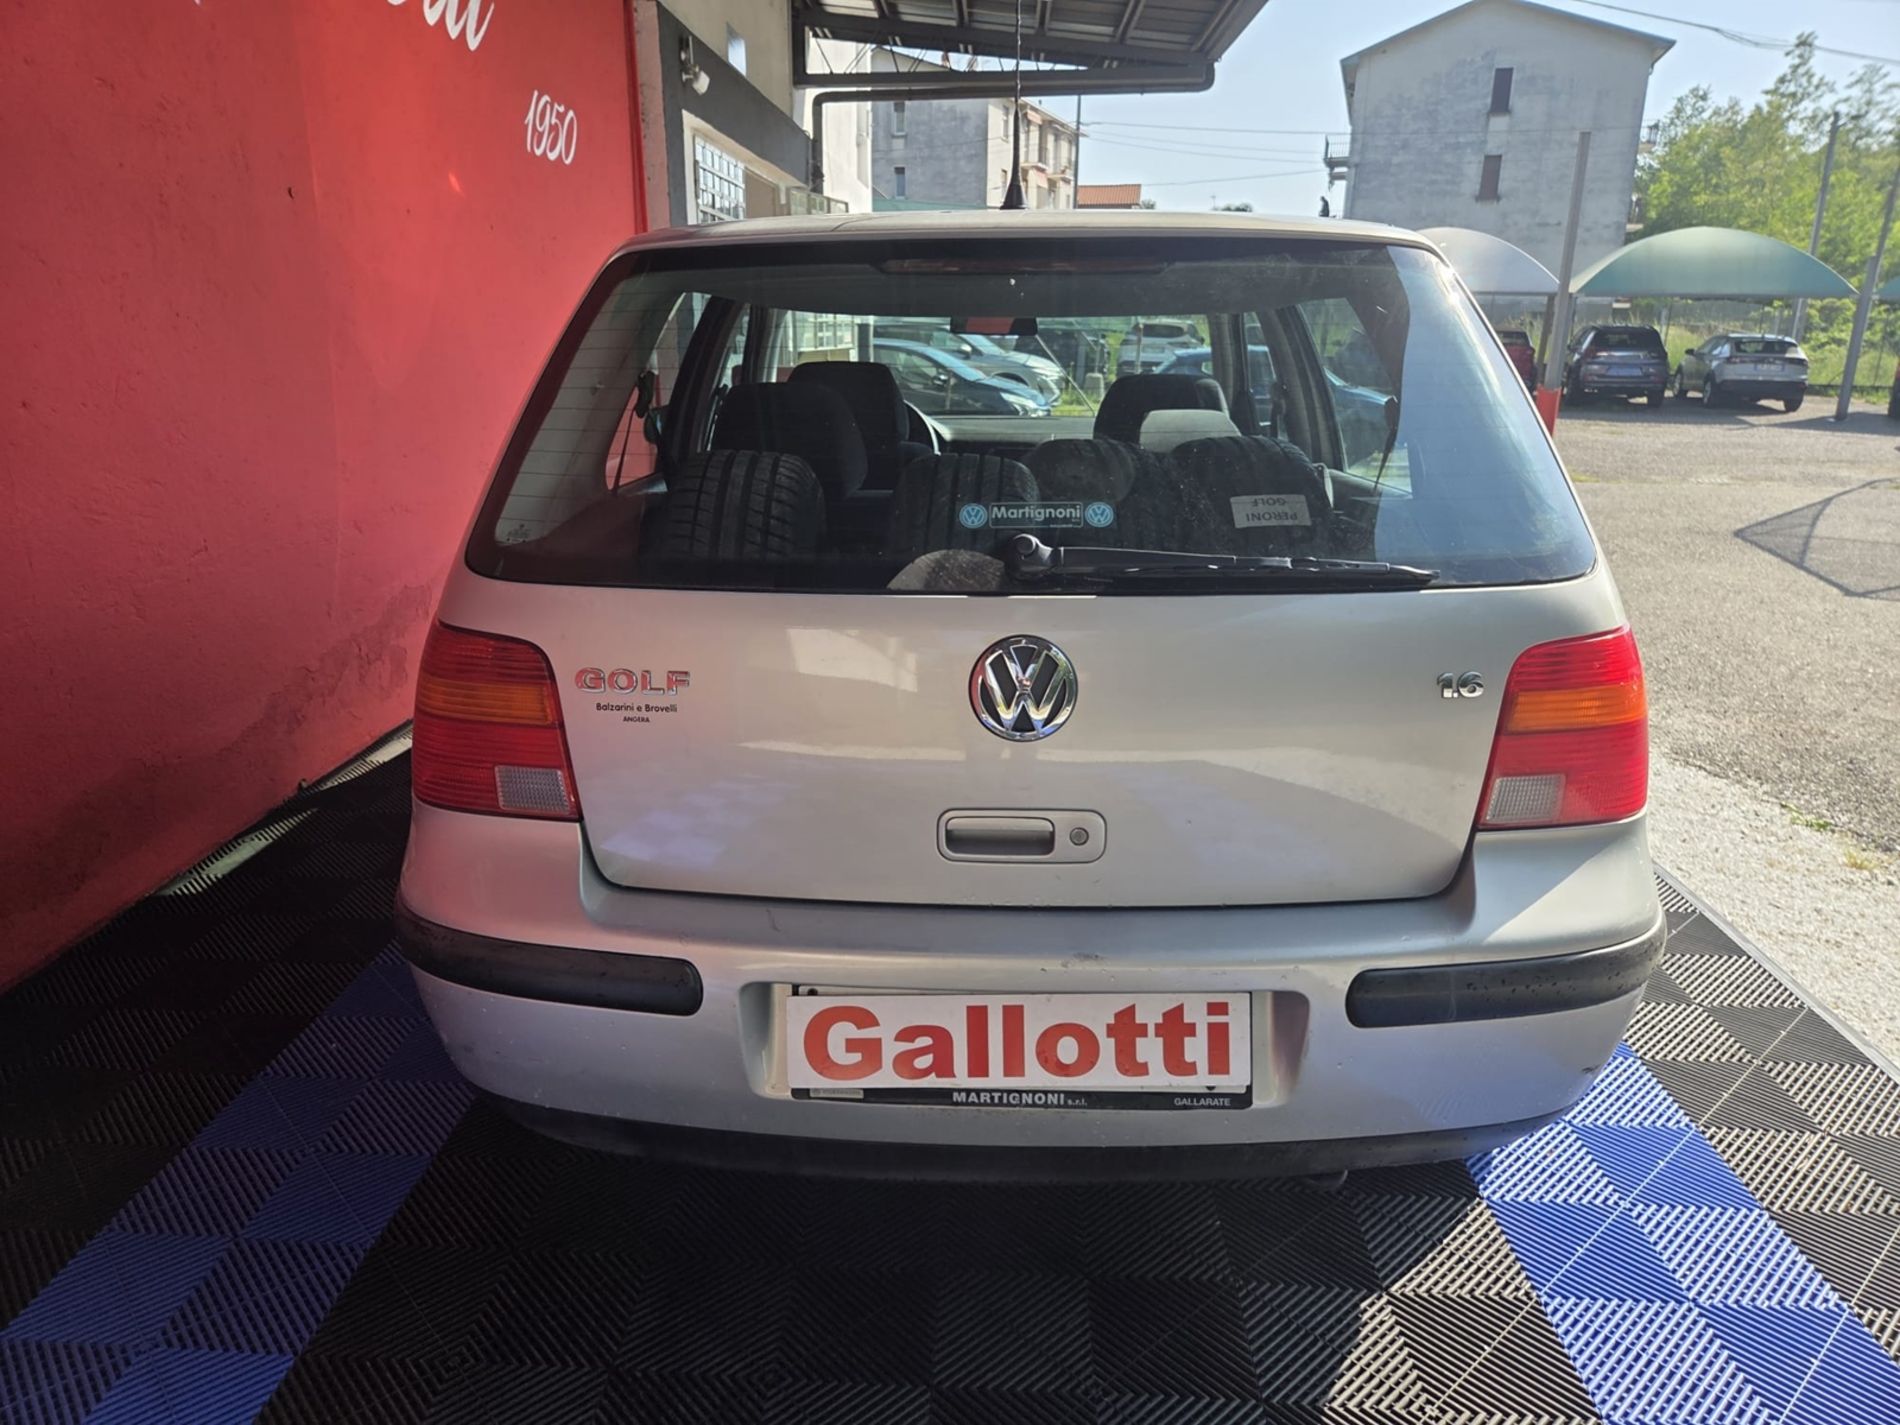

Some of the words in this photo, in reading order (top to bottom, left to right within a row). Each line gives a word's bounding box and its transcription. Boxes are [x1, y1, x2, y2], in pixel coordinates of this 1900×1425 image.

[525, 90, 577, 165] 1950
[1252, 497, 1287, 507] GOLF
[991, 505, 1081, 521] Martignoni
[1246, 511, 1298, 522] PERONI
[575, 667, 690, 696] GOLF
[1436, 671, 1484, 698] 1.6
[596, 702, 634, 712] Balzarini
[645, 703, 678, 713] Brovelli
[803, 1001, 1230, 1081] Gallotti
[952, 1091, 1065, 1106] MARTIGNONI
[1067, 1098, 1088, 1106] s.r.l.
[1174, 1097, 1231, 1107] GALLARATE
